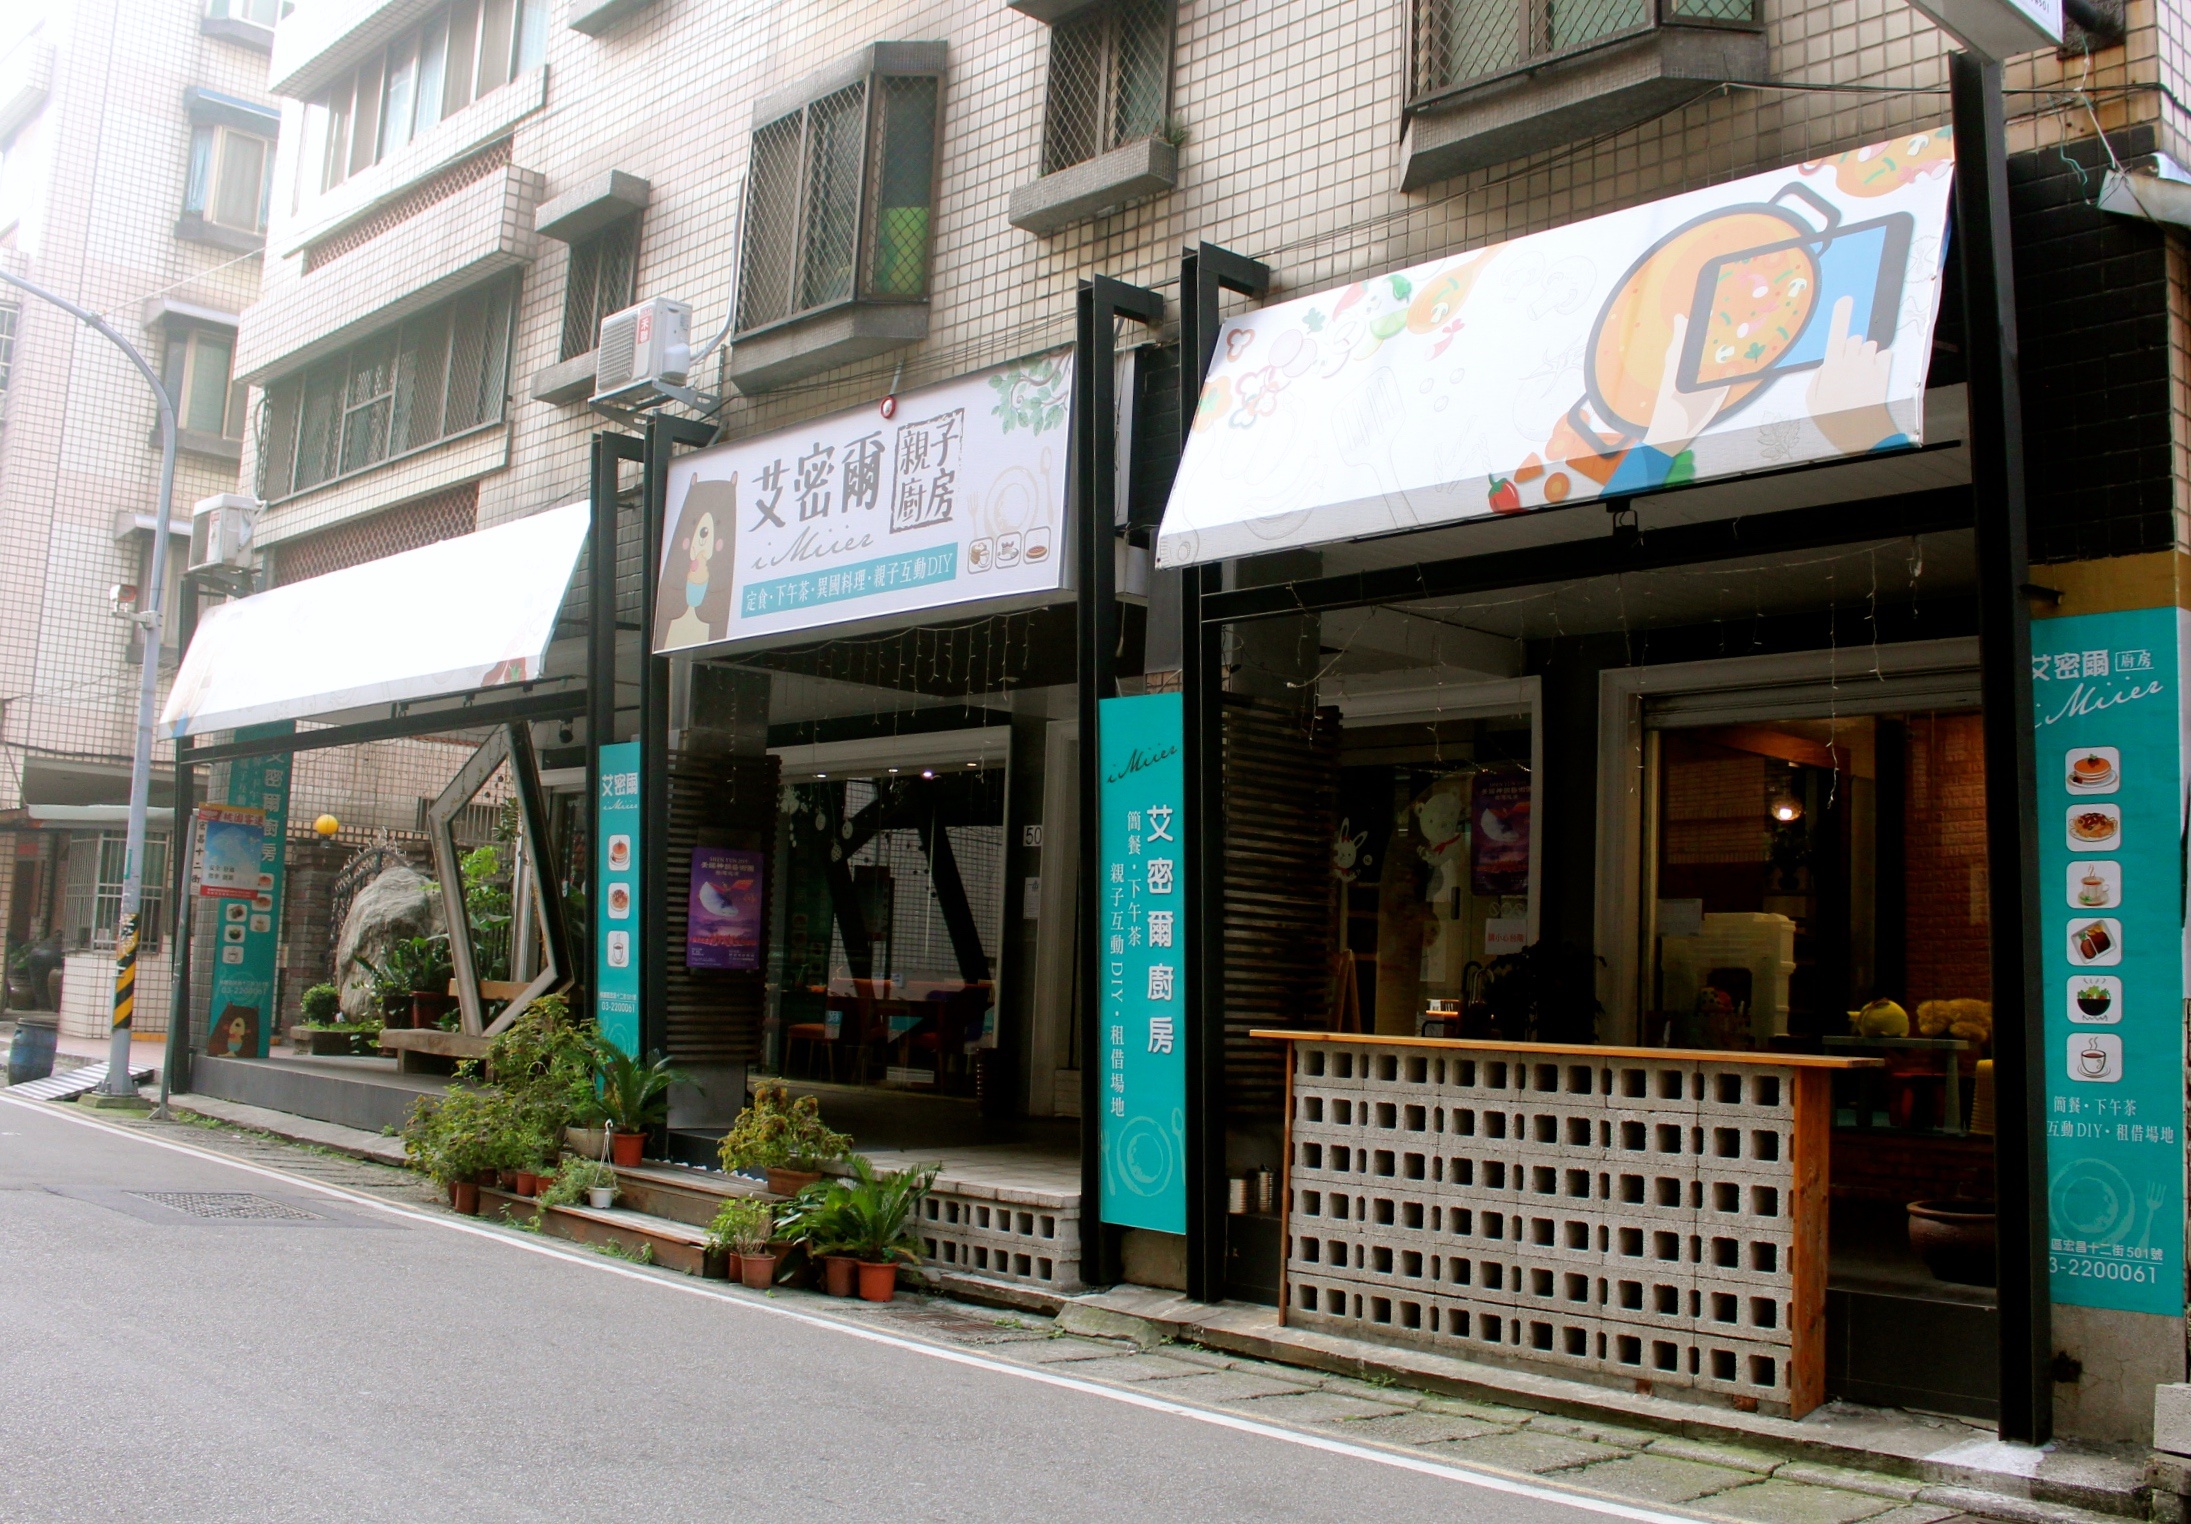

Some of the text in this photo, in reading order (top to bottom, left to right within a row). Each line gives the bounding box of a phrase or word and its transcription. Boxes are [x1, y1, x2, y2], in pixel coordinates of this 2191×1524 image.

[899, 419, 959, 475] 親子
[748, 430, 886, 532] 艾密爾
[896, 467, 956, 524] 廚房
[601, 772, 638, 797] 艾密爾
[191, 821, 207, 883] 宏昌十二街
[1147, 804, 1174, 1054] 艾密爾廚房
[601, 1001, 635, 1013] 03-2200061
